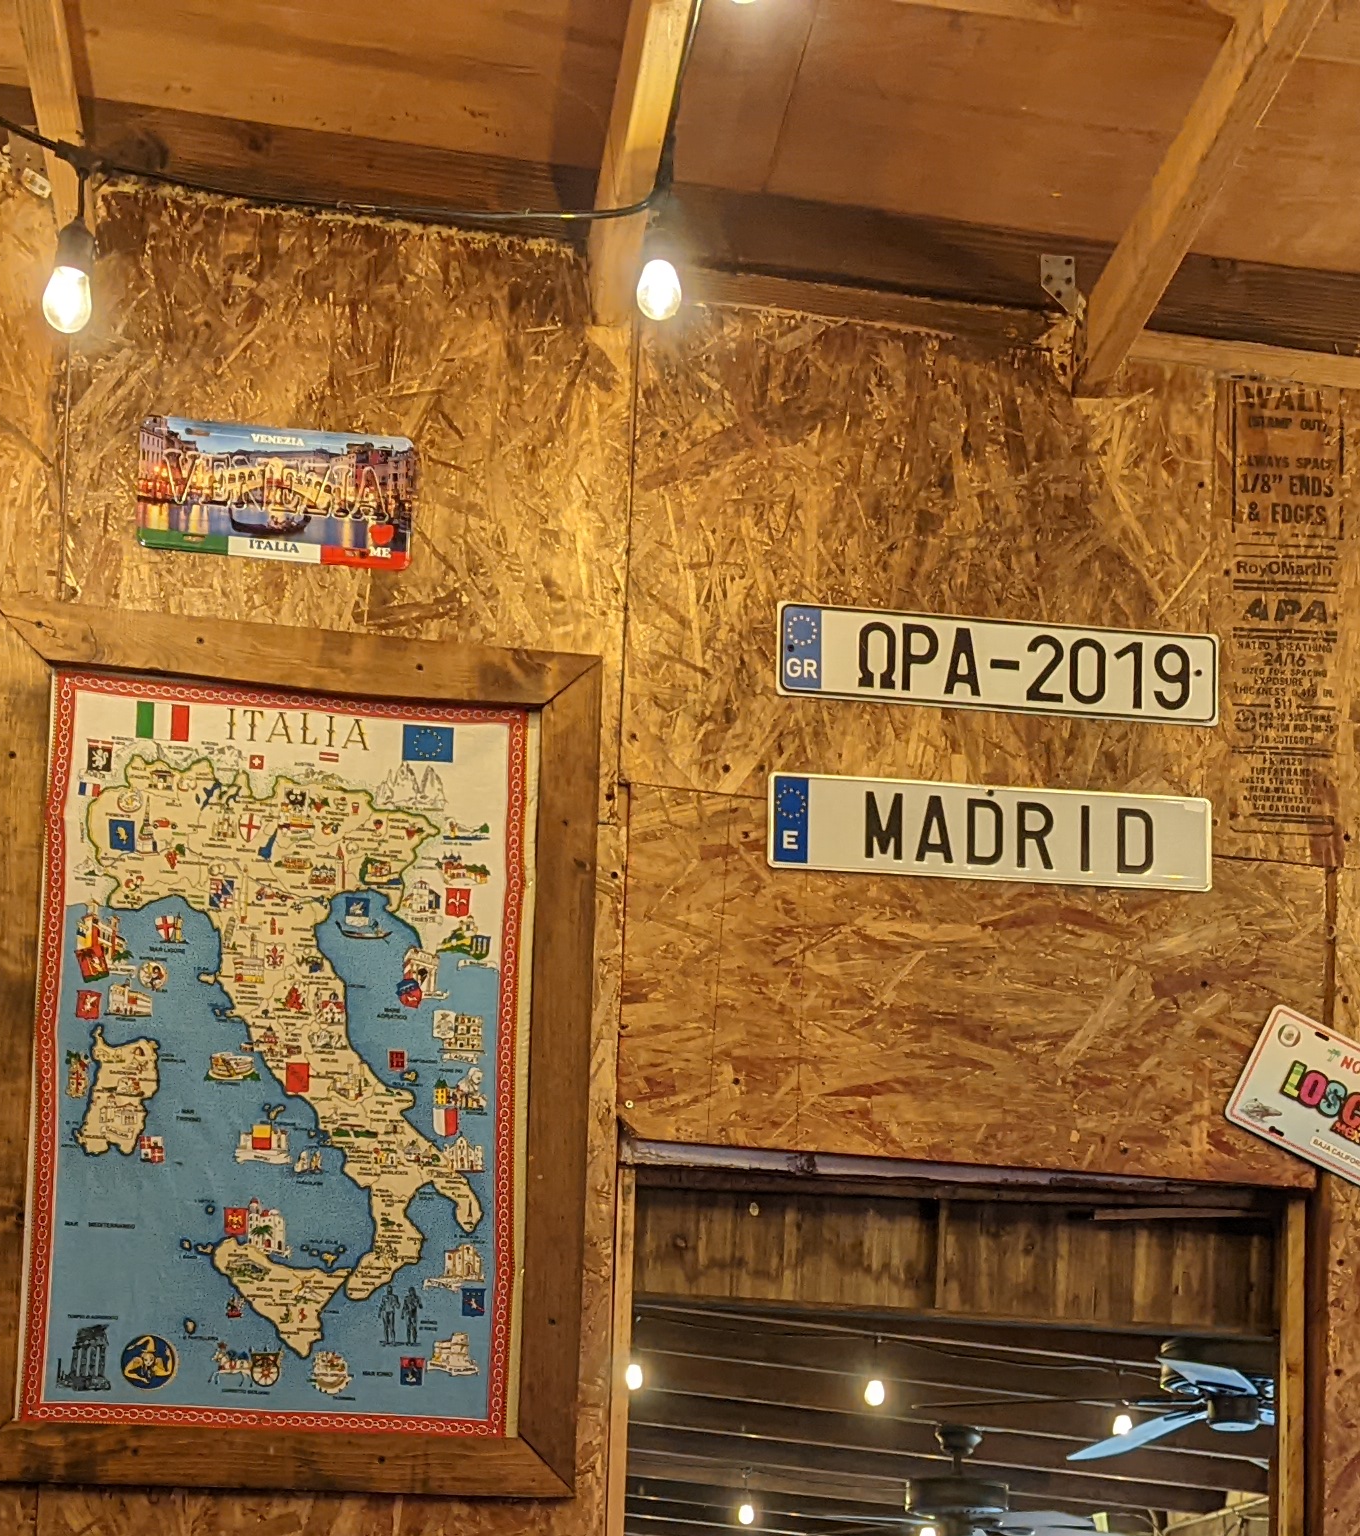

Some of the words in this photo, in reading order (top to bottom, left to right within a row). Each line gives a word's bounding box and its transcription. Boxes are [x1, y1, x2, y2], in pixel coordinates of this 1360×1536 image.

[251, 433, 306, 447] VENEZIA
[163, 449, 390, 522] VENEZIA
[1289, 475, 1335, 498] ENDS
[1247, 501, 1262, 522] &
[1271, 502, 1328, 526] EDGES
[249, 539, 300, 554] ITALIA
[369, 547, 392, 559] ME
[1236, 560, 1333, 578] RoyOMartin
[1242, 598, 1328, 624] APA
[785, 657, 818, 680] GR
[1262, 651, 1307, 668] 24/16
[1254, 676, 1304, 687] EXPOSURE
[226, 708, 372, 753] ITALIA
[782, 830, 799, 851] E
[864, 790, 1155, 875] MADRID
[1279, 1059, 1347, 1119] LOS
[1312, 1138, 1332, 1152] BAJA
